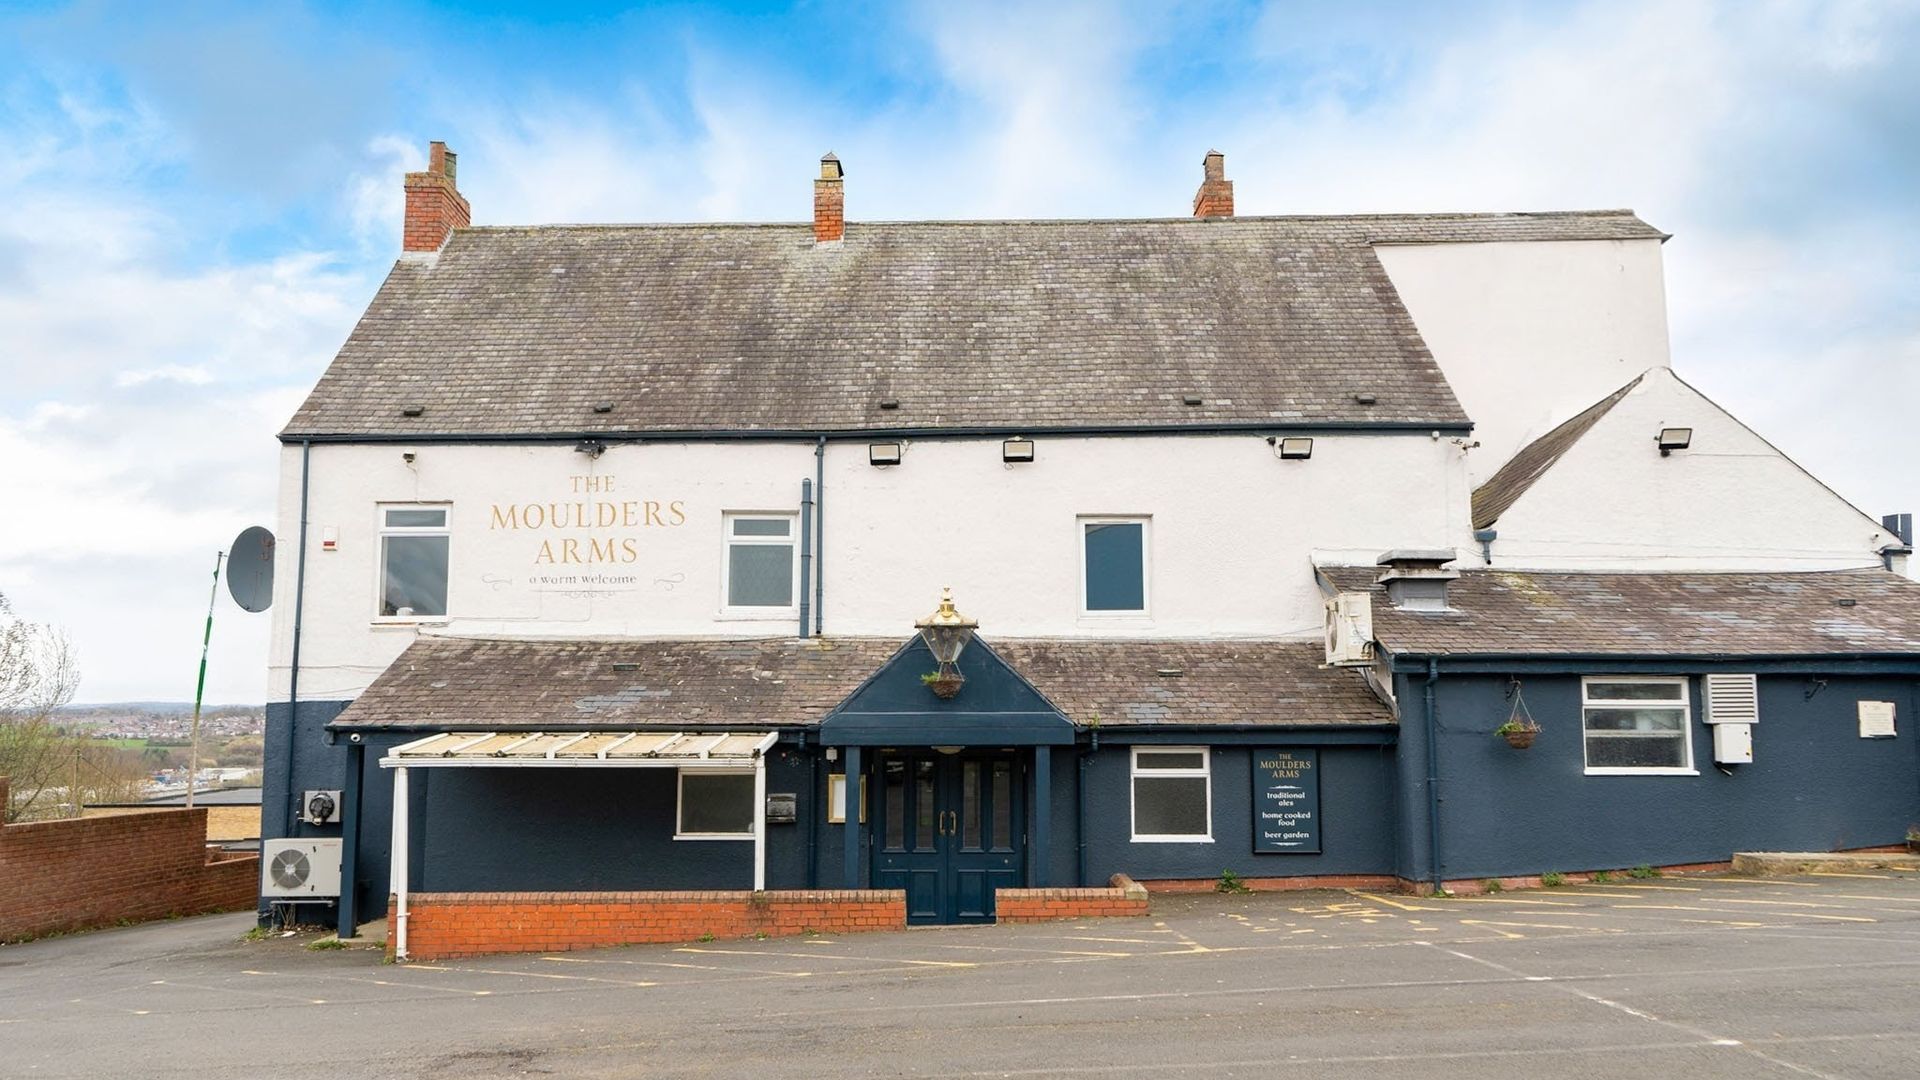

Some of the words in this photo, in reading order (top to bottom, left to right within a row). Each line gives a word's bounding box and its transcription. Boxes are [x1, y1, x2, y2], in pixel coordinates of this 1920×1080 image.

[570, 475, 616, 493] THE
[490, 500, 686, 530] MOULDERS
[535, 537, 638, 564] ARMS
[529, 575, 537, 584] a
[541, 575, 577, 584] warm
[581, 573, 637, 584] welcome
[1260, 761, 1311, 769] MOULDERS
[1272, 770, 1300, 778] ARMS
[1283, 831, 1310, 839] garden
